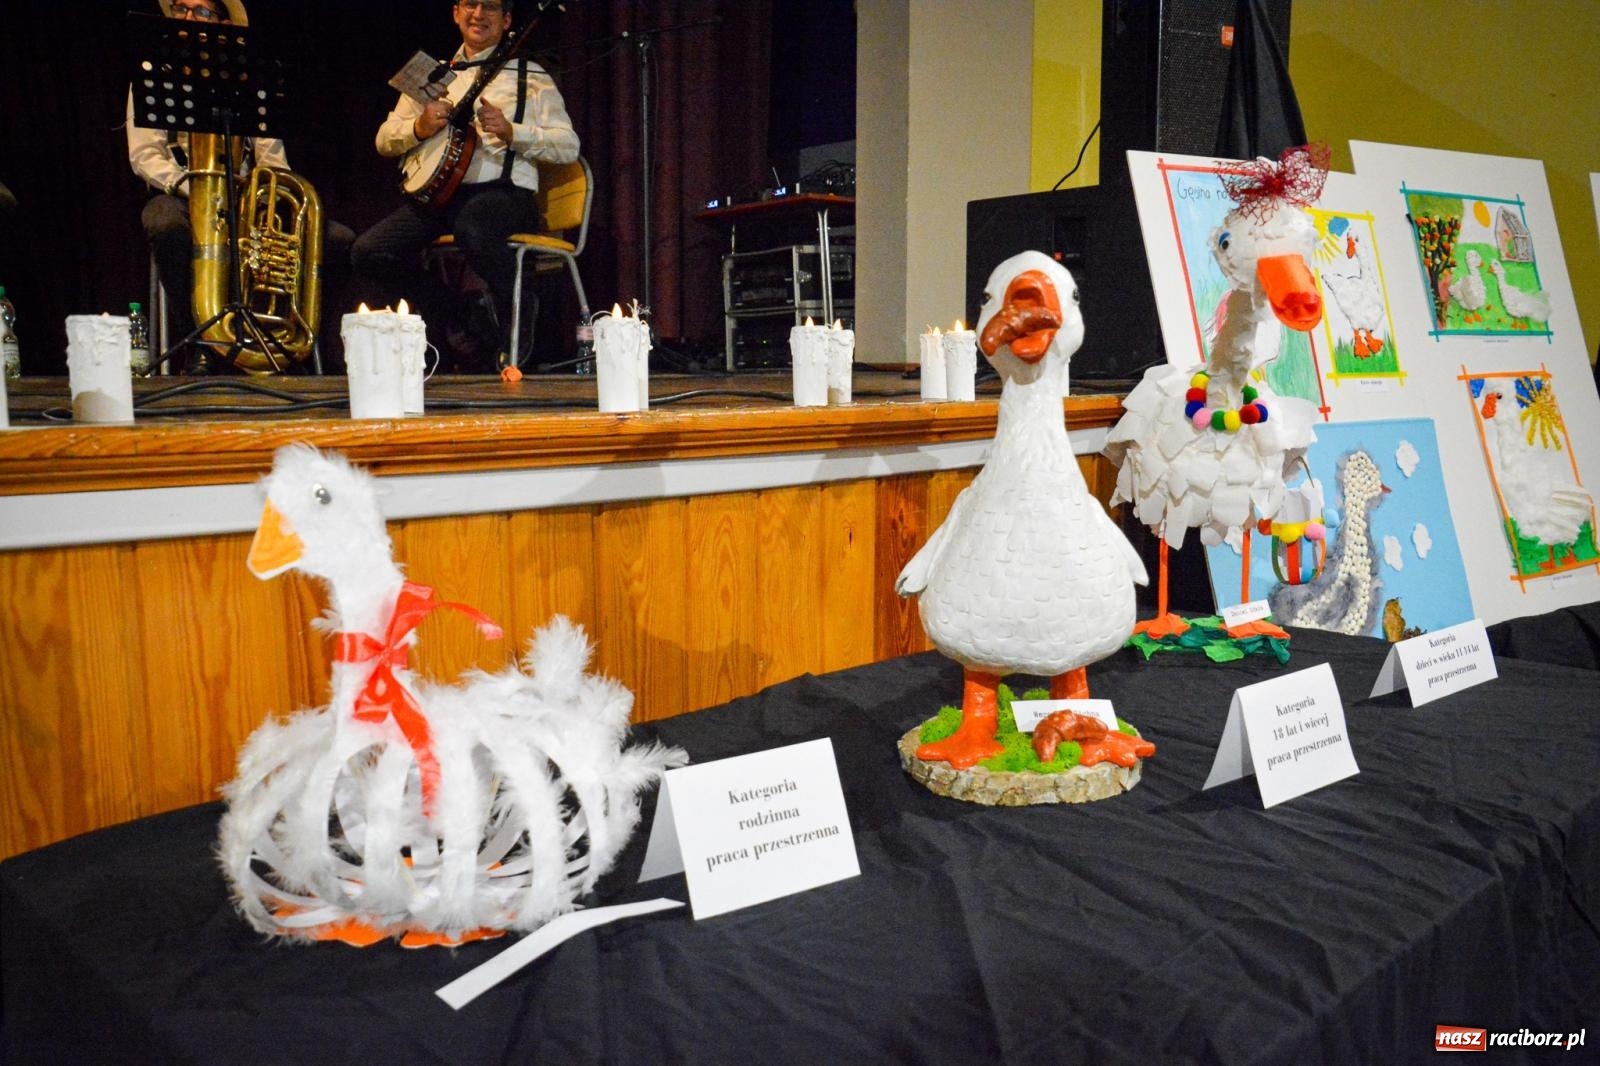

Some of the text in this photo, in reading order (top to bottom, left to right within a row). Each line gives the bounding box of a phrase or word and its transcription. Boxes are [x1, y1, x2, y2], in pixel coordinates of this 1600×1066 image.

[1428, 633, 1457, 649] Kategoria
[1428, 662, 1477, 688] praca przestrzenna
[1276, 696, 1316, 717] Kategoria
[1272, 713, 1330, 741] 18 lat i więcej
[1267, 733, 1343, 771] praca przestrzenna
[727, 778, 798, 805] Kategoria
[738, 807, 801, 831] rodzinna
[705, 823, 840, 873] praca przestrzenna
